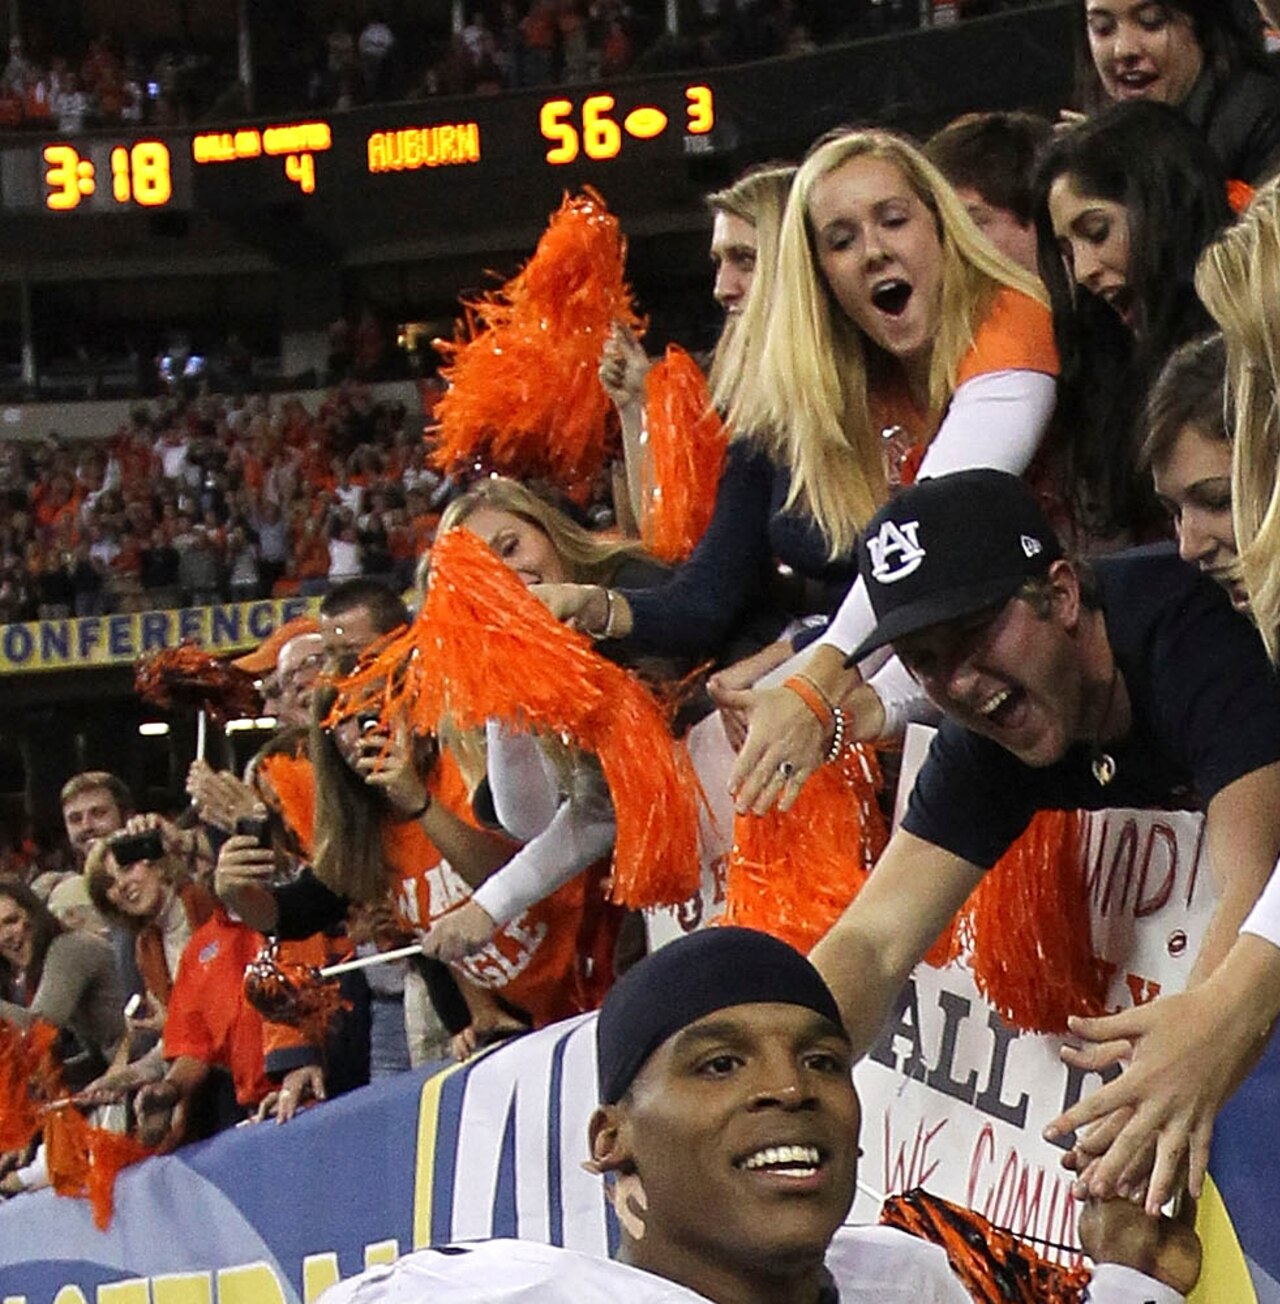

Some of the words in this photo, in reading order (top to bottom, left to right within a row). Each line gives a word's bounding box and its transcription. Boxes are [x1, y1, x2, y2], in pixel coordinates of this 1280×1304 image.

[539, 96, 621, 164] 56
[685, 83, 714, 134] 3
[285, 153, 315, 193] 4
[367, 122, 481, 174] AUBURN
[44, 141, 171, 210] 3:18
